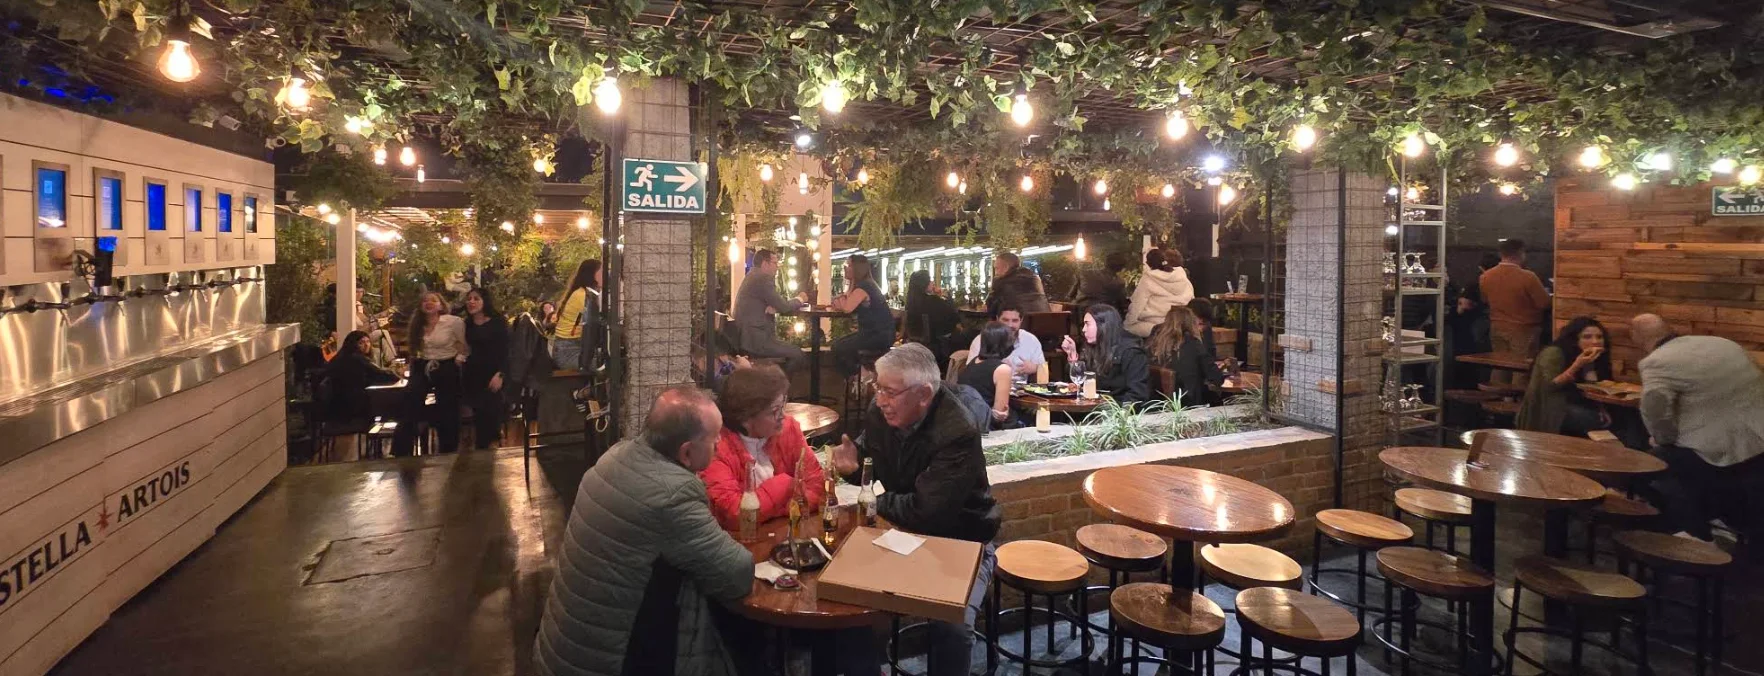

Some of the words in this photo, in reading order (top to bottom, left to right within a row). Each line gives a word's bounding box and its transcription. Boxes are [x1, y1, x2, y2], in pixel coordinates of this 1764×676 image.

[628, 193, 699, 208] SALIDA
[0, 521, 91, 606] STELLA
[117, 461, 190, 523] ARTOIS
